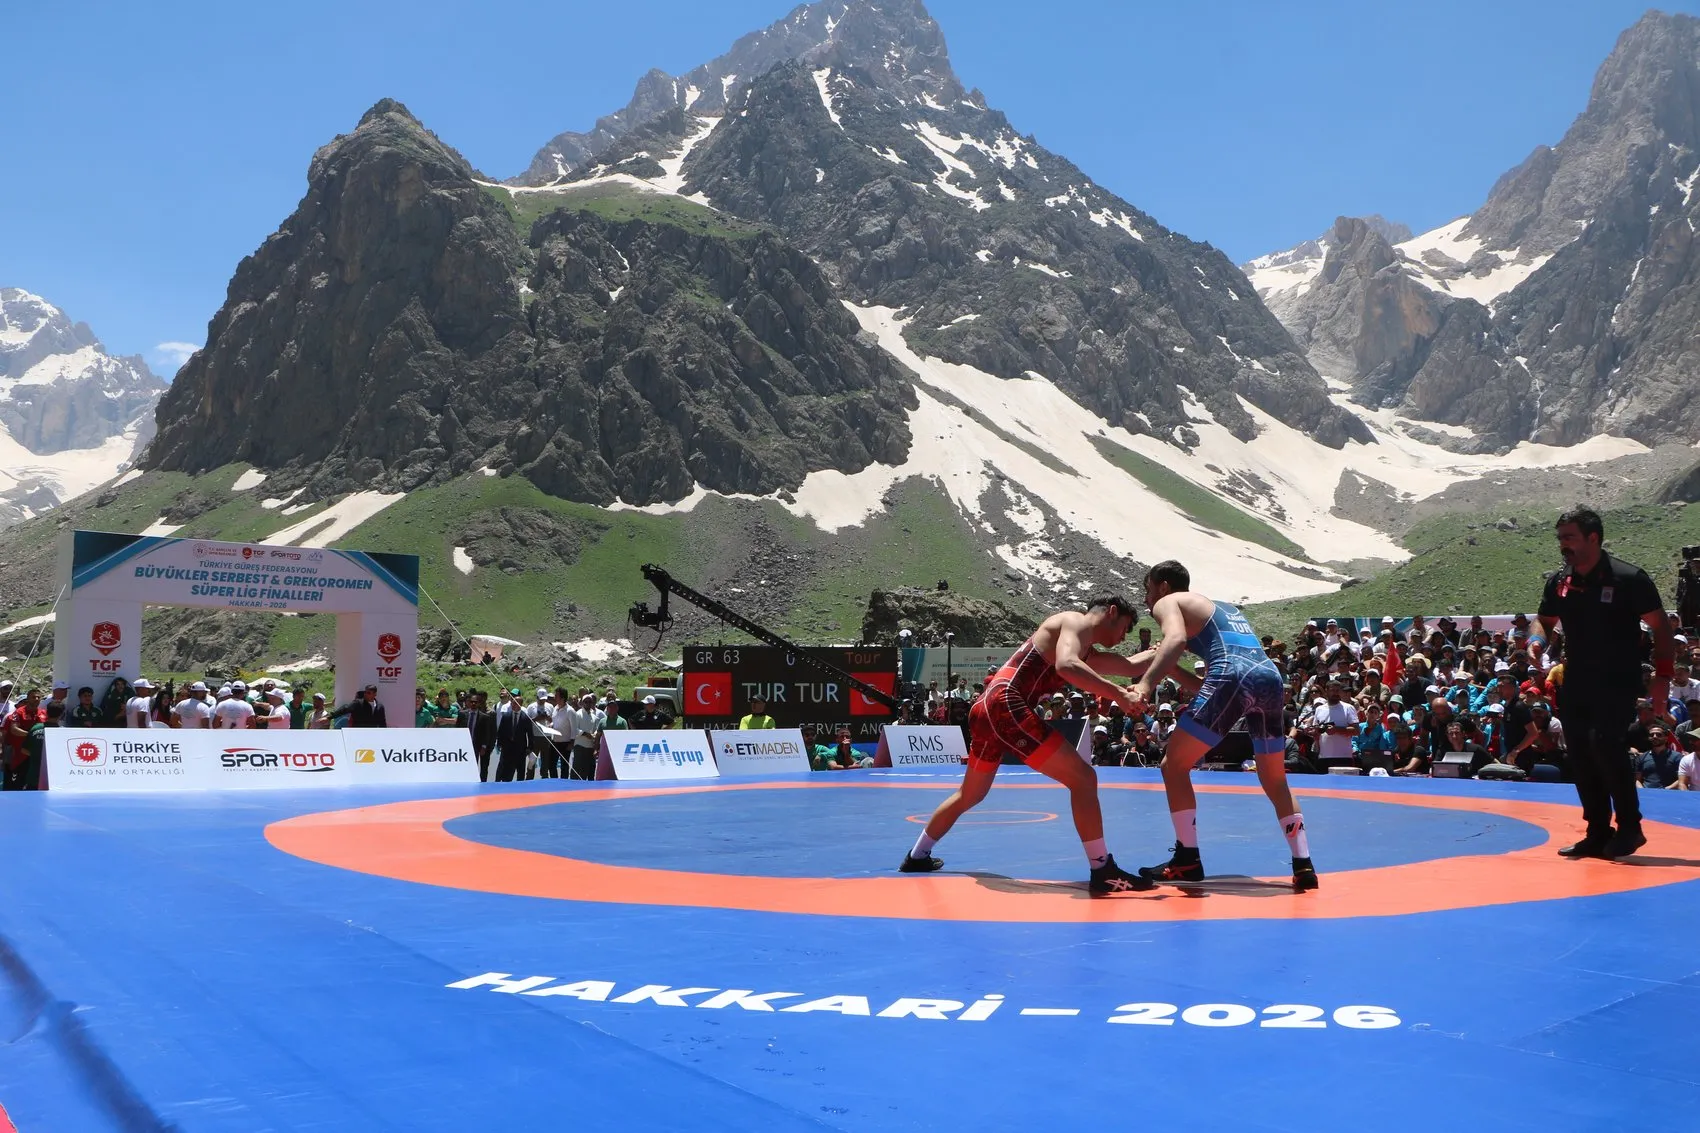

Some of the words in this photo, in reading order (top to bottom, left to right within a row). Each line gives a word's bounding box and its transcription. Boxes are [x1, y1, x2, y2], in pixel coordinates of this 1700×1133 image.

[200, 561, 232, 569] TÜRKİYE
[234, 563, 259, 572] GÜREŞ
[261, 565, 318, 574] FEDERASYONU
[134, 564, 209, 580] BÜYÜKLER
[211, 571, 269, 584] SERBEST
[270, 575, 280, 585] &
[283, 575, 373, 590] GREKOROMEN
[191, 582, 235, 597] SÜPER
[236, 584, 258, 598] LİG
[259, 586, 323, 601] FİNALLERİ
[228, 600, 262, 608] HAKKARİ
[1228, 621, 1254, 634] TUR
[695, 651, 713, 664] GR
[723, 650, 740, 664] 63
[845, 652, 881, 664] Tour
[89, 660, 121, 671] TGF
[376, 667, 402, 677] TGF
[742, 683, 786, 702] TUR
[794, 683, 839, 702] TUR
[113, 741, 180, 753] TÜRKİYE
[907, 735, 944, 752] RMS
[81, 748, 94, 756] TP
[113, 754, 182, 763] PETROLLERİ
[381, 749, 468, 763] VakıfBank
[220, 753, 335, 767] SPORTOTO
[898, 754, 962, 764] ZEITMEISTER
[123, 767, 185, 775] ORTAKLIĞI
[1106, 1002, 1401, 1029] 2026
